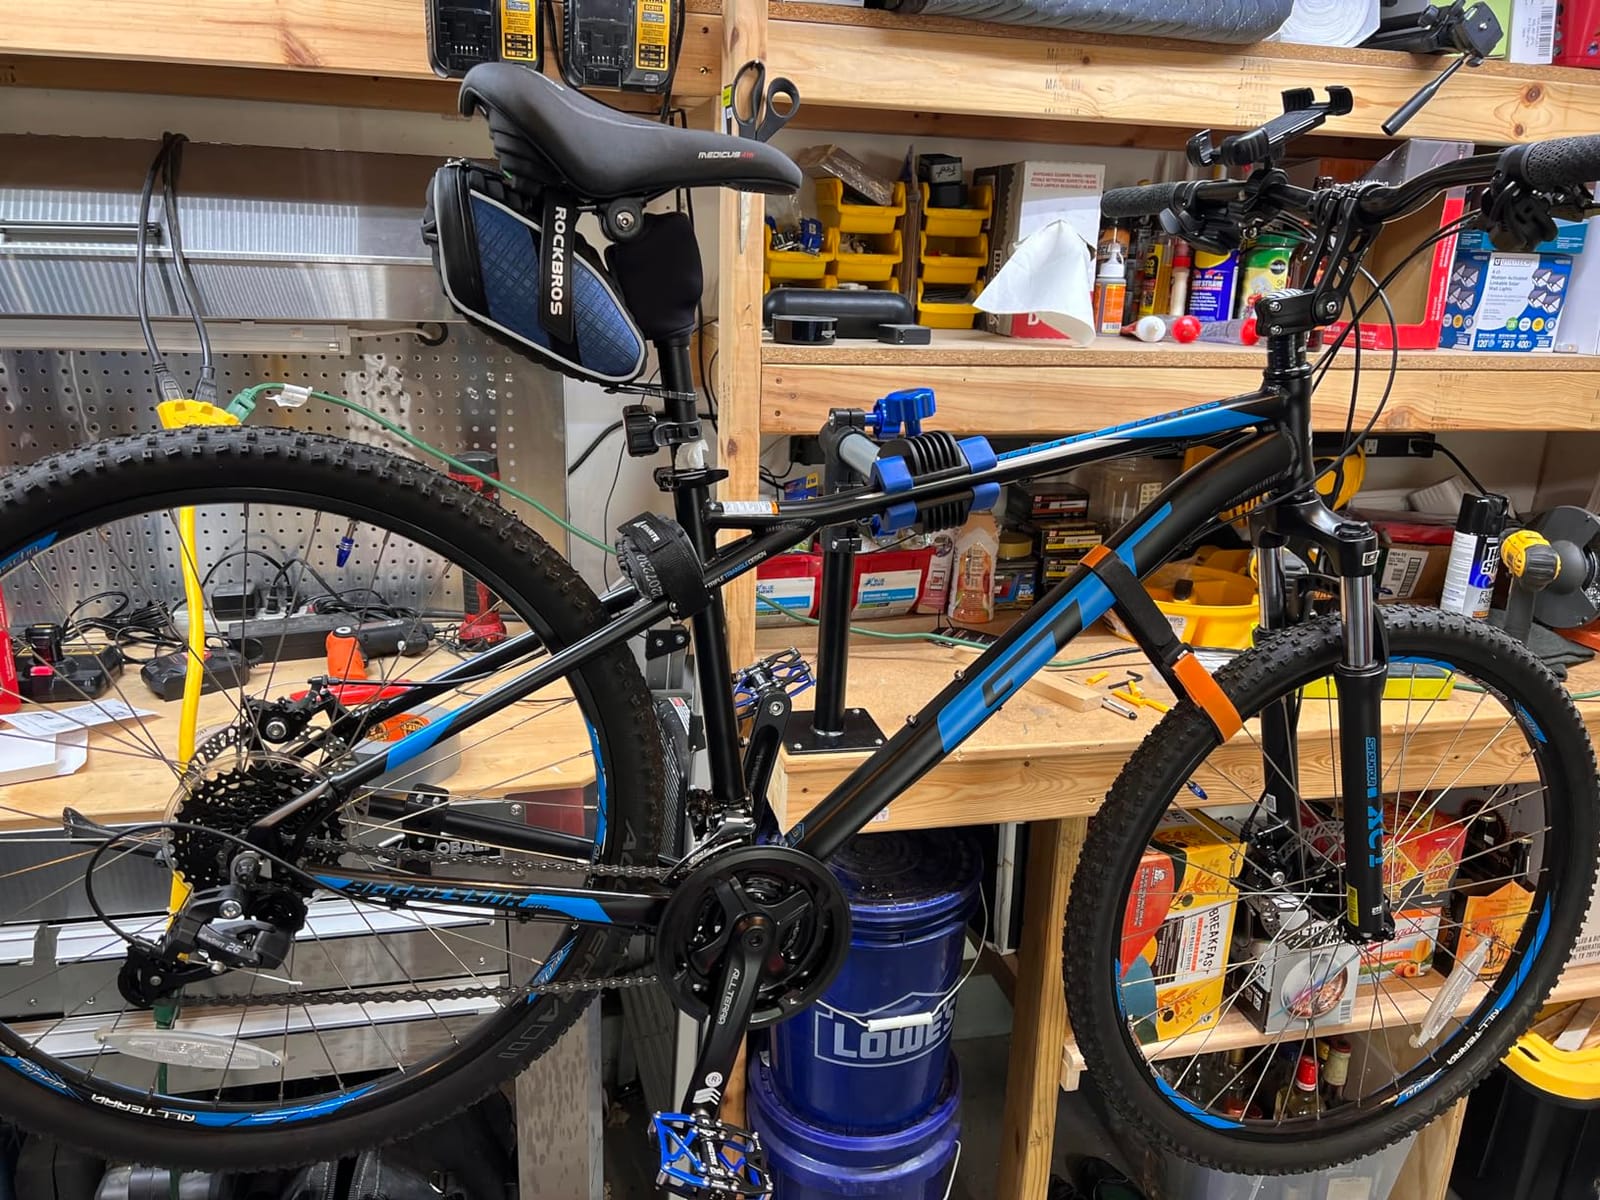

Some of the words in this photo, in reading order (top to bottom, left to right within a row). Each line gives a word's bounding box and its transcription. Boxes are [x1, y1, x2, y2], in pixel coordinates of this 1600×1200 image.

[698, 151, 741, 159] MEDICUS
[550, 206, 567, 315] ROCKBROS
[225, 942, 243, 954] 26
[833, 999, 955, 1059] LOWE'S
